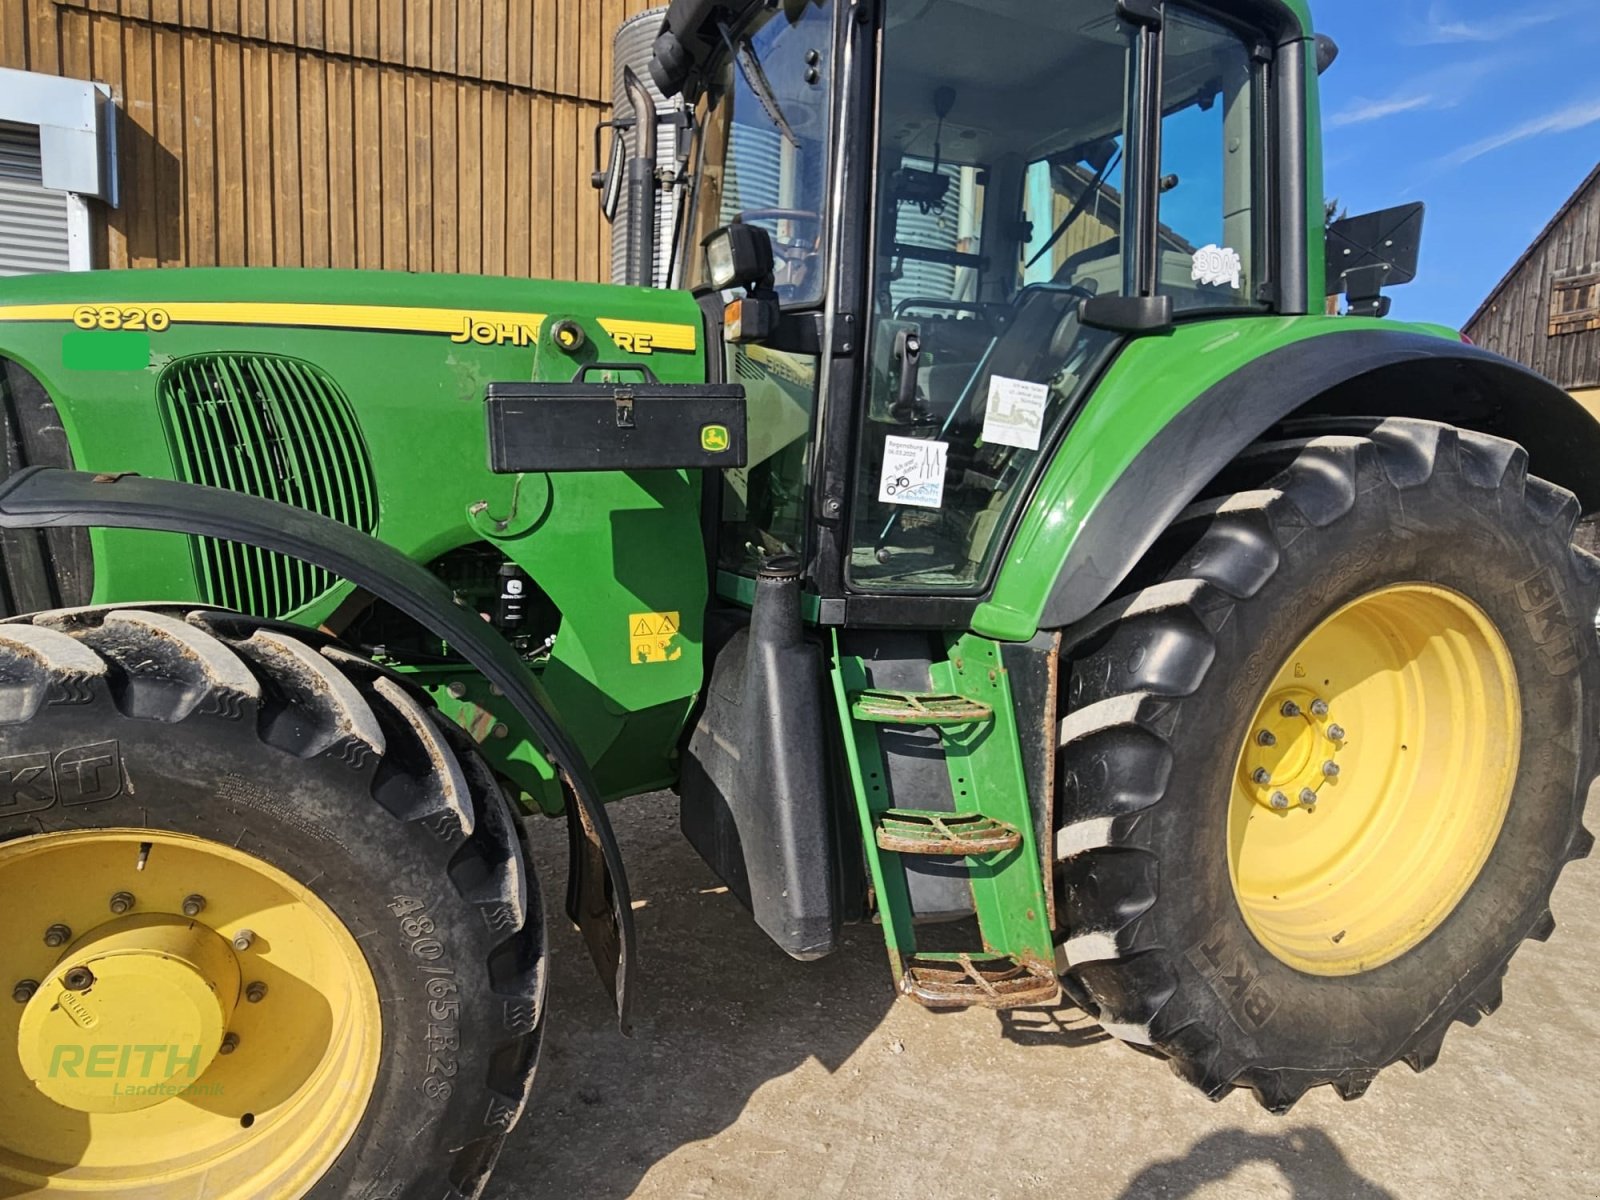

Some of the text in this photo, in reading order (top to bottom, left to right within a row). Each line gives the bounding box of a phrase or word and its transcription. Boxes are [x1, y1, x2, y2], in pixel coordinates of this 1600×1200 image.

[1196, 250, 1238, 277] BDM
[73, 306, 171, 331] 6820
[450, 316, 539, 346] JOHN
[387, 895, 461, 1101] 480/65R28
